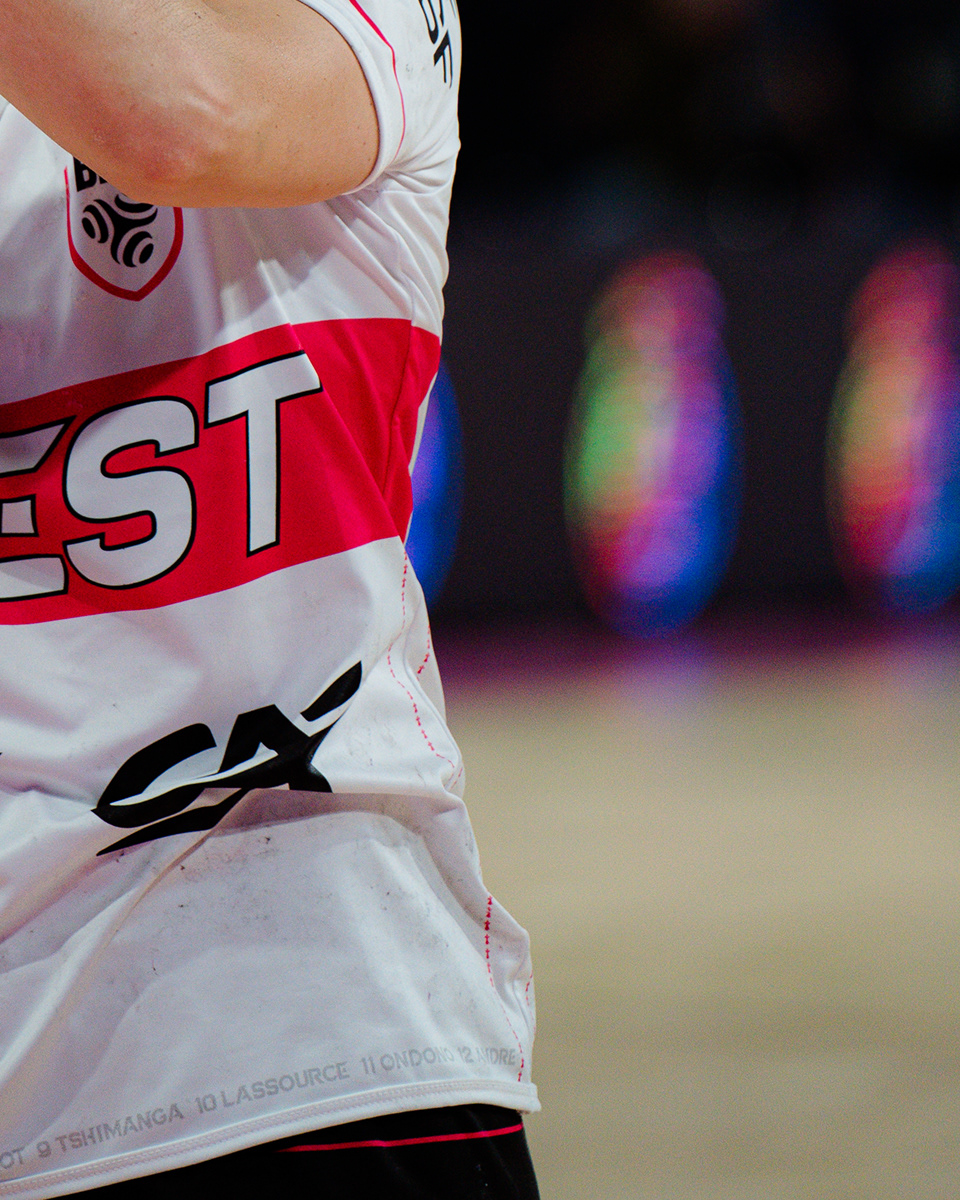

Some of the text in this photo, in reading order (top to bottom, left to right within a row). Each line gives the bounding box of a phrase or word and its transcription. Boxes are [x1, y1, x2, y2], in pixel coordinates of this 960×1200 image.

[37, 1141, 50, 1158] 9
[55, 1103, 184, 1154] TSHIMANGA
[195, 1094, 217, 1114] 10
[220, 1061, 350, 1108] LASSOURCE
[361, 1057, 375, 1075] 11
